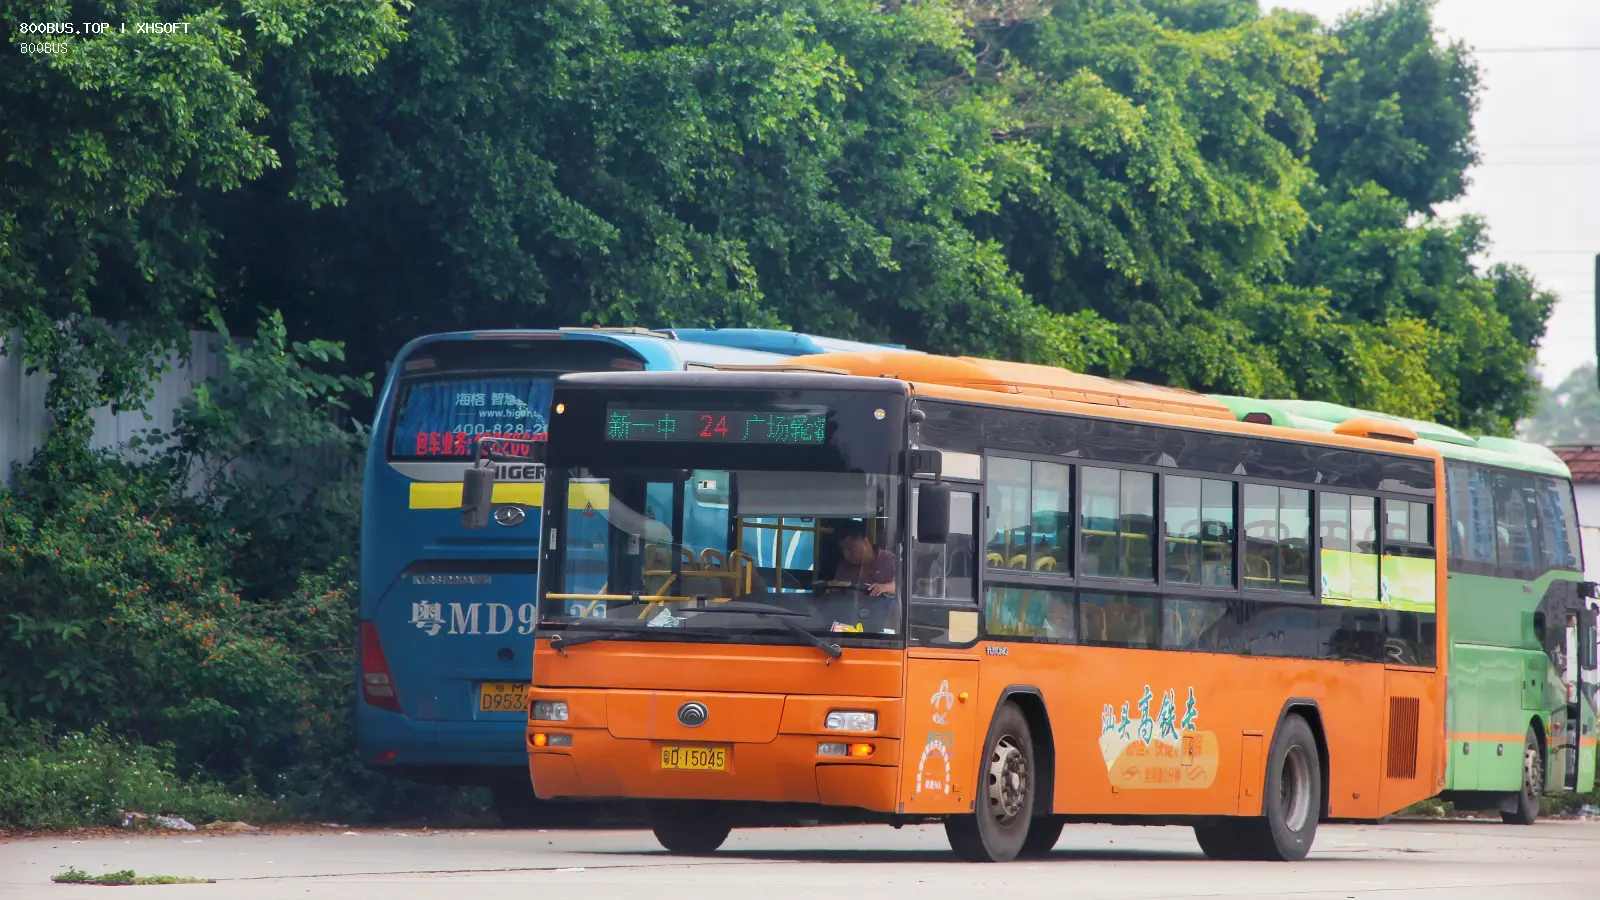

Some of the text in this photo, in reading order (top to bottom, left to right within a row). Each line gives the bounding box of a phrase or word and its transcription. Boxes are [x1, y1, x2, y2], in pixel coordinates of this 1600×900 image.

[456, 393, 485, 406] 海格
[608, 411, 676, 439] 新一中
[700, 414, 728, 437] 24
